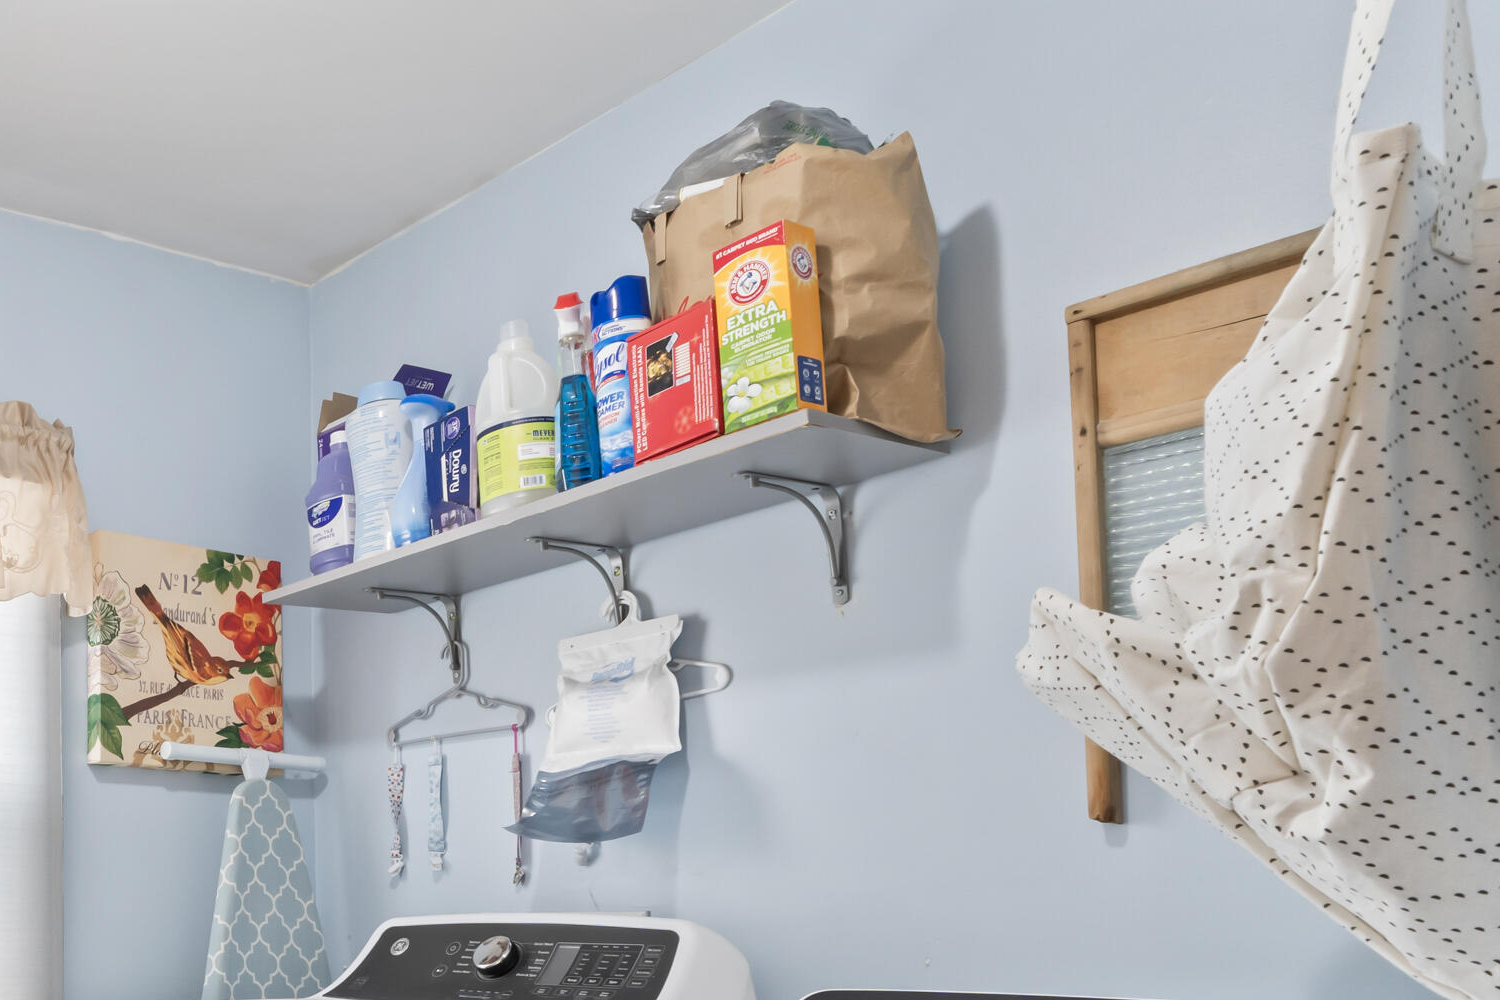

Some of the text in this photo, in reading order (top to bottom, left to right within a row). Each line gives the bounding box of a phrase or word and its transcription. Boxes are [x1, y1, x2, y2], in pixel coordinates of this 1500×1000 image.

[743, 262, 769, 281] HAMMER
[727, 300, 778, 331] EXTRA
[721, 310, 787, 346] STRENGTH
[595, 342, 625, 390] ysol
[597, 391, 625, 411] OWER
[449, 448, 462, 493] Downy
[153, 602, 216, 626] andurand's
[203, 687, 225, 701] PARIS
[137, 708, 232, 729] PARIS FRANCE
